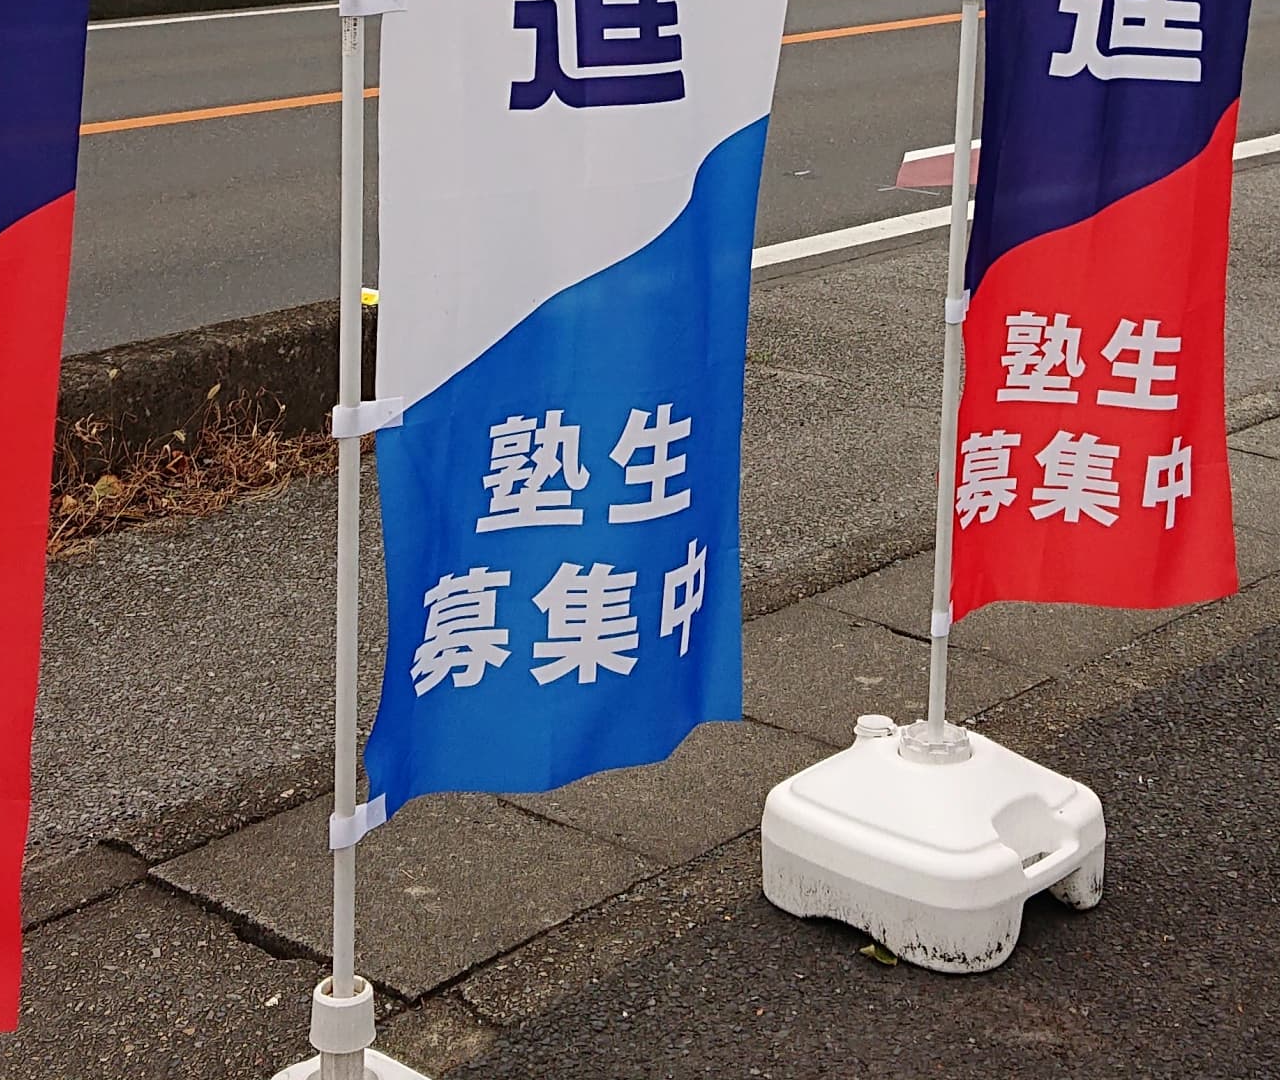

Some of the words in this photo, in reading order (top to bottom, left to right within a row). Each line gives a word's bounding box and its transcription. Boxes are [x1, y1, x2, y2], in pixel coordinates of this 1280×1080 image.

[996, 310, 1182, 411] 塾生
[475, 403, 692, 533] 塾生
[957, 429, 1192, 530] 募集中
[410, 539, 707, 697] 募集中
